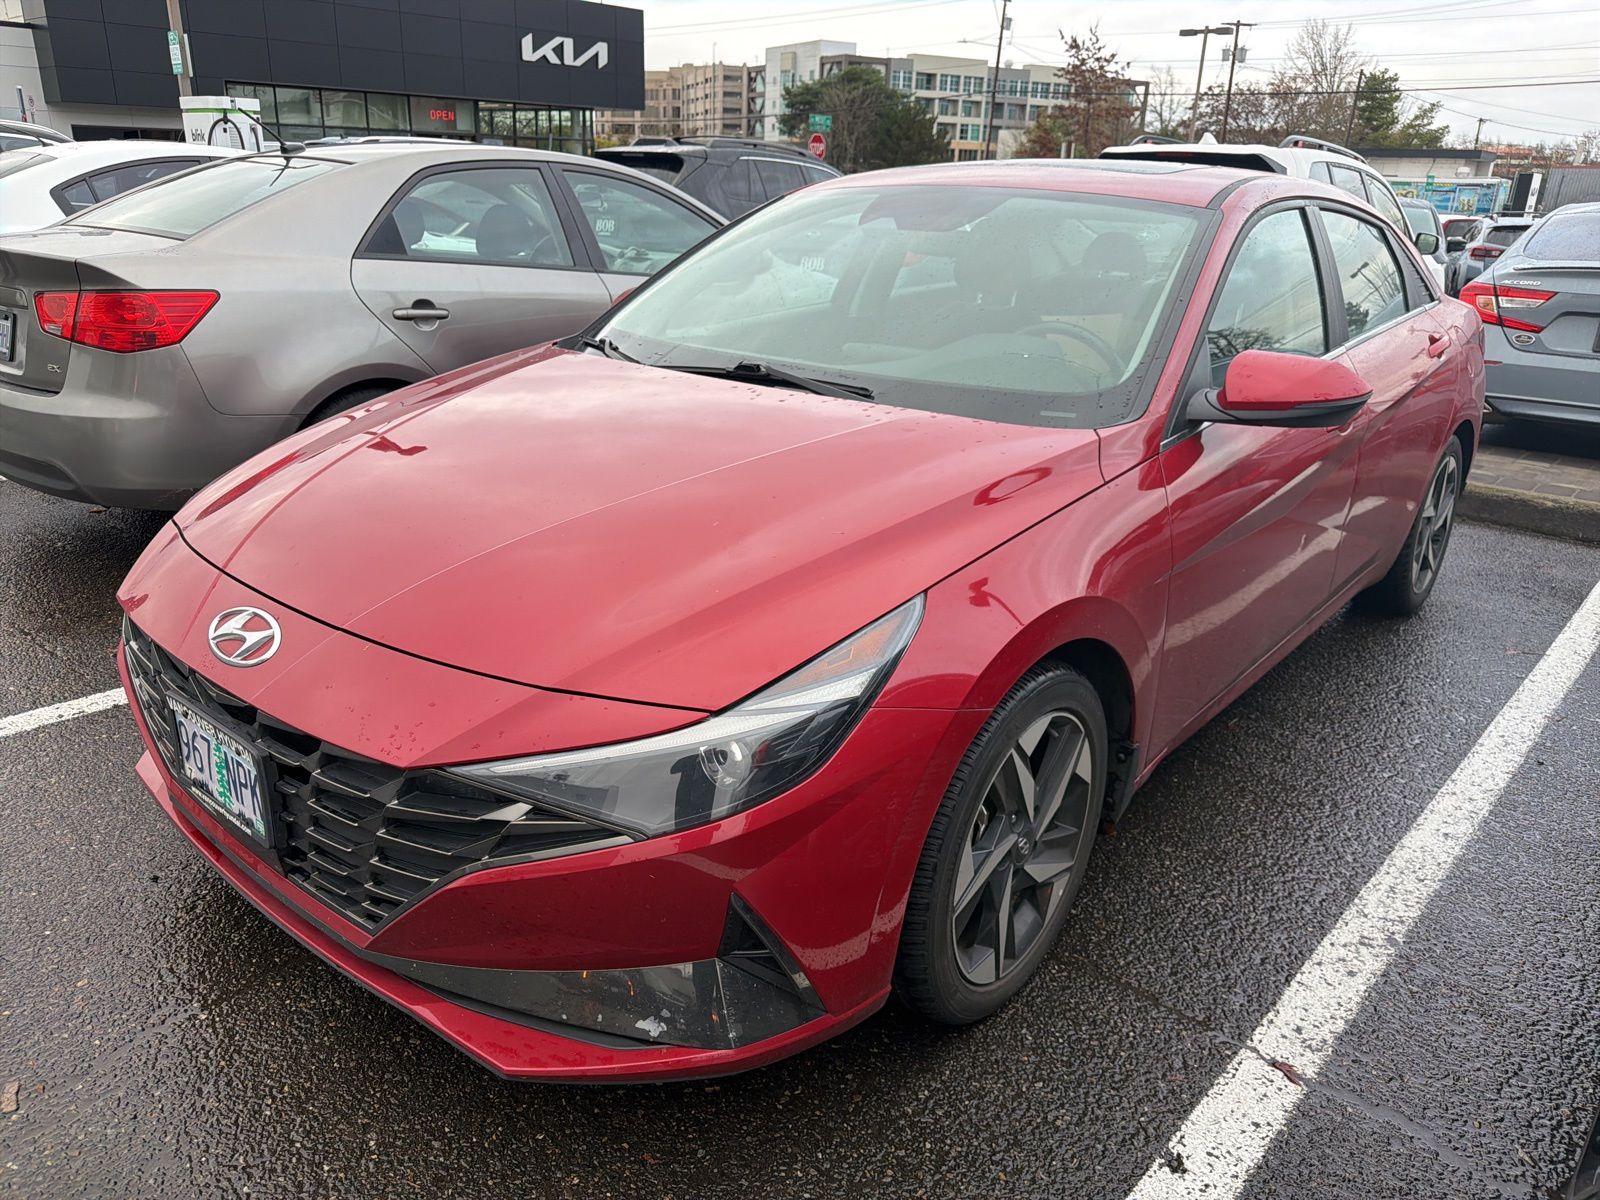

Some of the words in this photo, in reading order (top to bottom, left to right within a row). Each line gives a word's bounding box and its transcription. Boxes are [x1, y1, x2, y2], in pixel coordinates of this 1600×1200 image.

[521, 32, 609, 70] KIA
[429, 108, 455, 121] OPEN
[190, 128, 206, 142] blink
[809, 142, 826, 155] STOP
[47, 363, 62, 373] EX
[178, 719, 213, 781] 967
[223, 749, 263, 817] NPK
